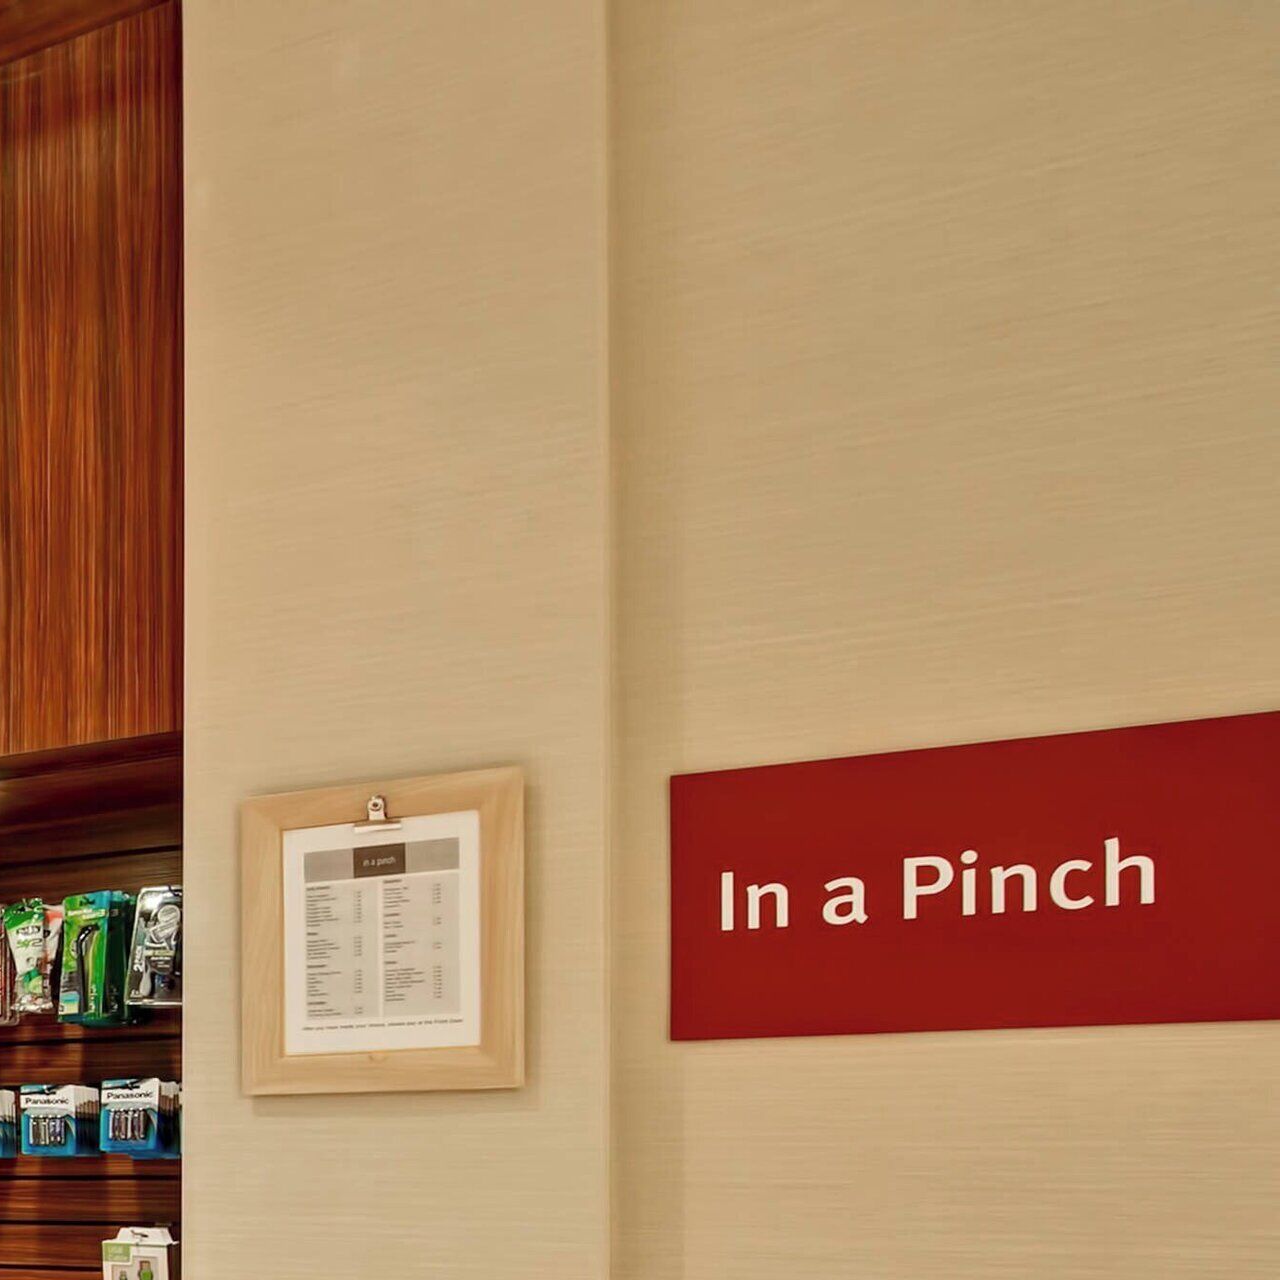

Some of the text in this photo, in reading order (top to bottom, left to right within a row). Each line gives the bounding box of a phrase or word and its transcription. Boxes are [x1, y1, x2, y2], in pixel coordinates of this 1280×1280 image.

[720, 836, 1156, 931] In a Pinch
[107, 1090, 154, 1100] Panasonic
[25, 1096, 69, 1106] Panasonic
